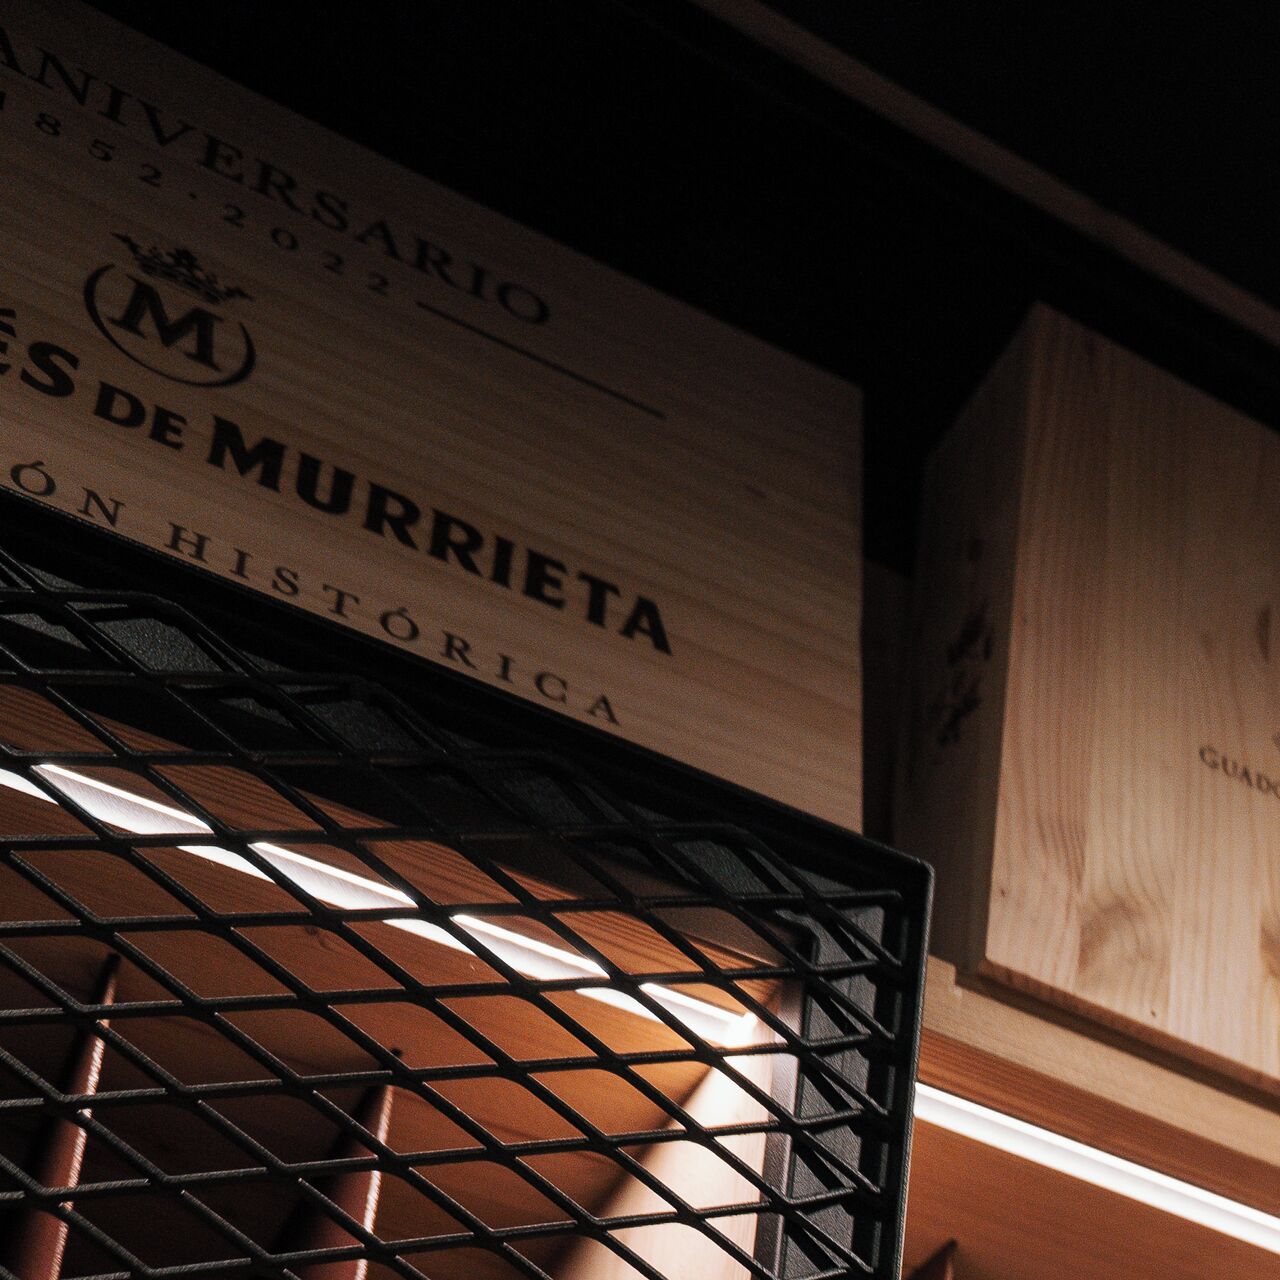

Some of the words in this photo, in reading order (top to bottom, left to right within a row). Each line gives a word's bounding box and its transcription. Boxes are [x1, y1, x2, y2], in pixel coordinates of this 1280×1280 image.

[94, 381, 187, 451] DE
[207, 415, 673, 656] MURRIETA
[164, 521, 621, 726] HISTÓRICA
